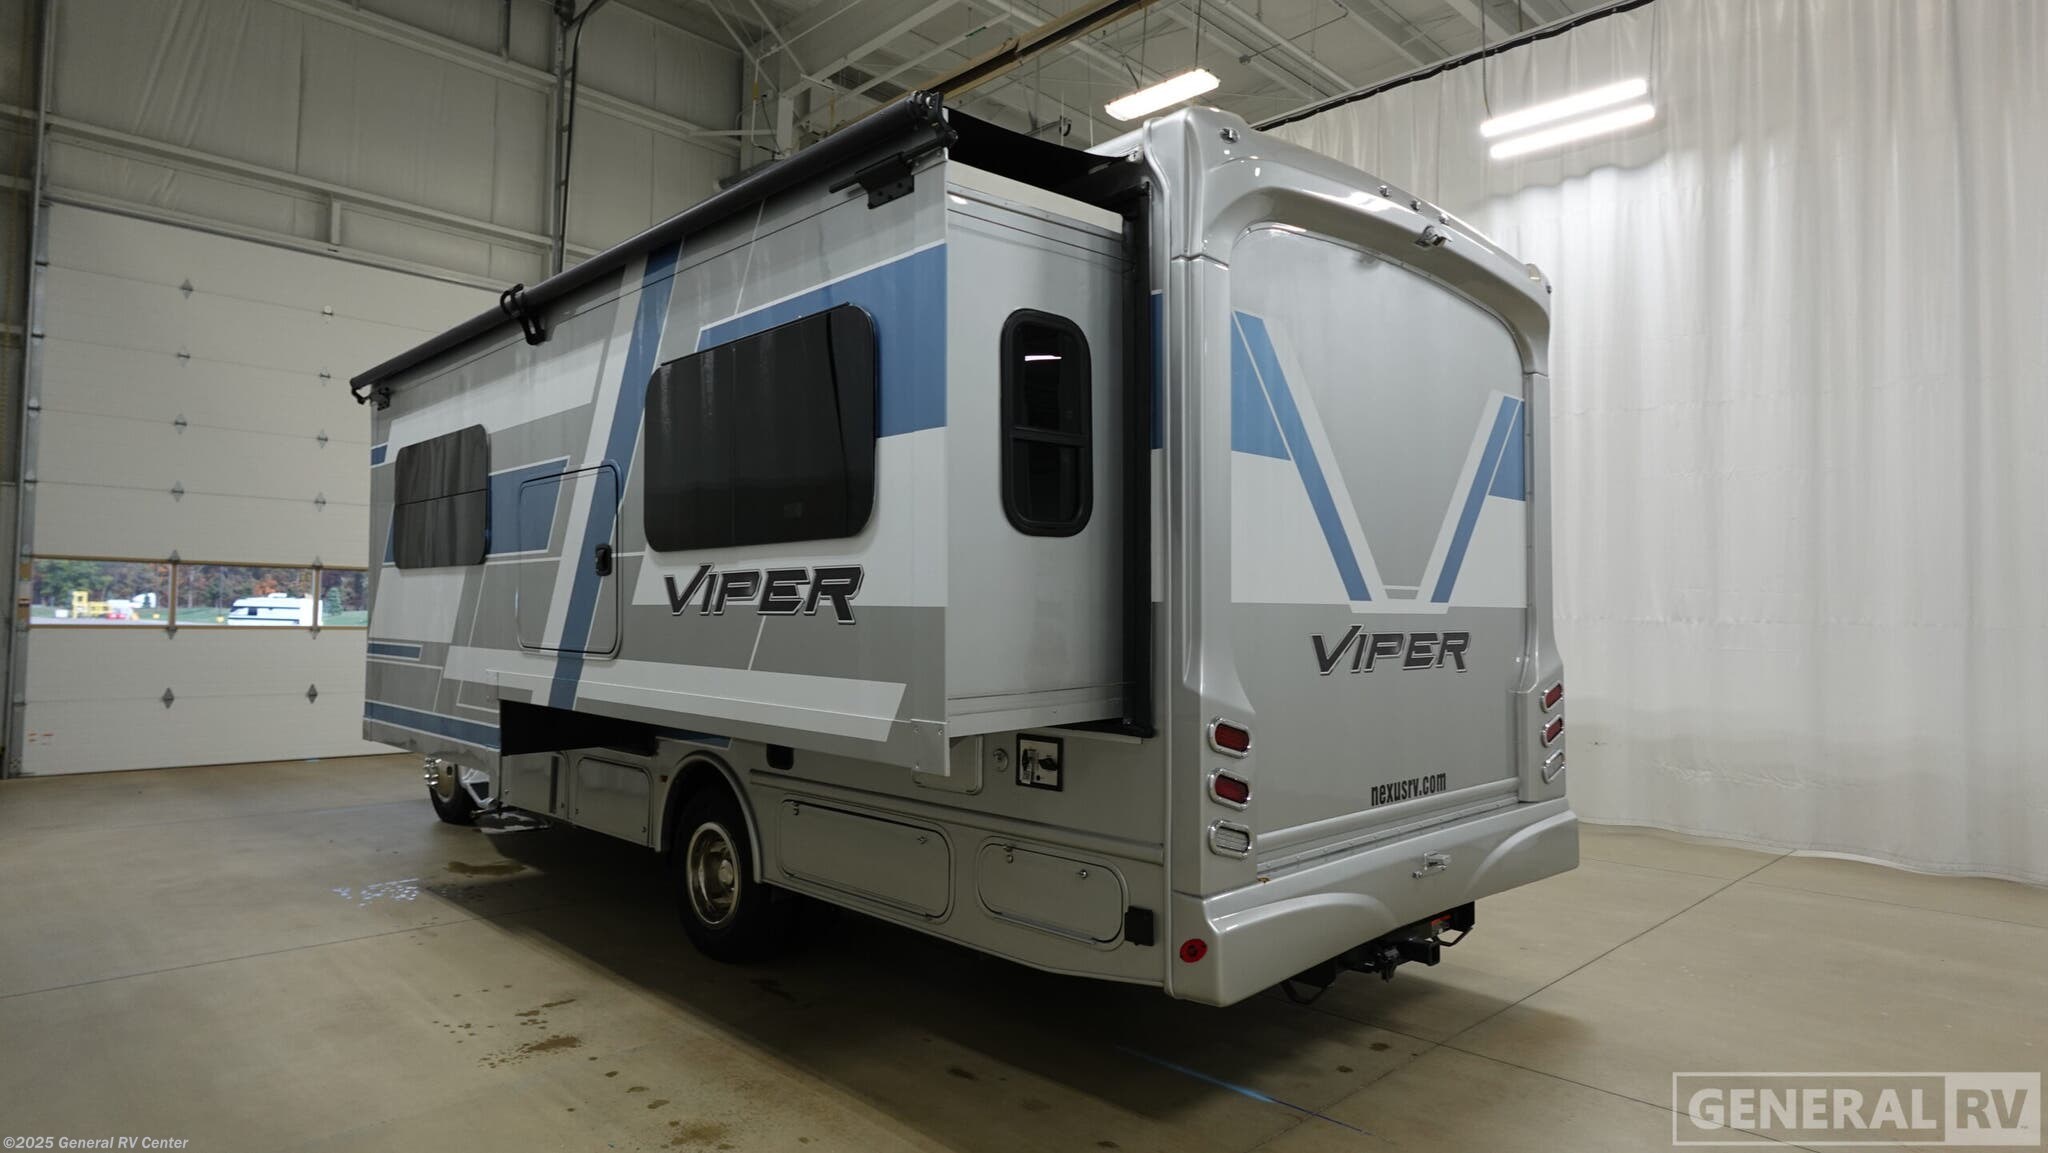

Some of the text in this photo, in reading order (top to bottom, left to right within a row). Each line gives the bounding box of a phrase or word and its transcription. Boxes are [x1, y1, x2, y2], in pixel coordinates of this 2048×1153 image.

[664, 563, 864, 624] VIPER
[1311, 624, 1471, 675] VIPER
[1371, 772, 1446, 806] nexusrv.com
